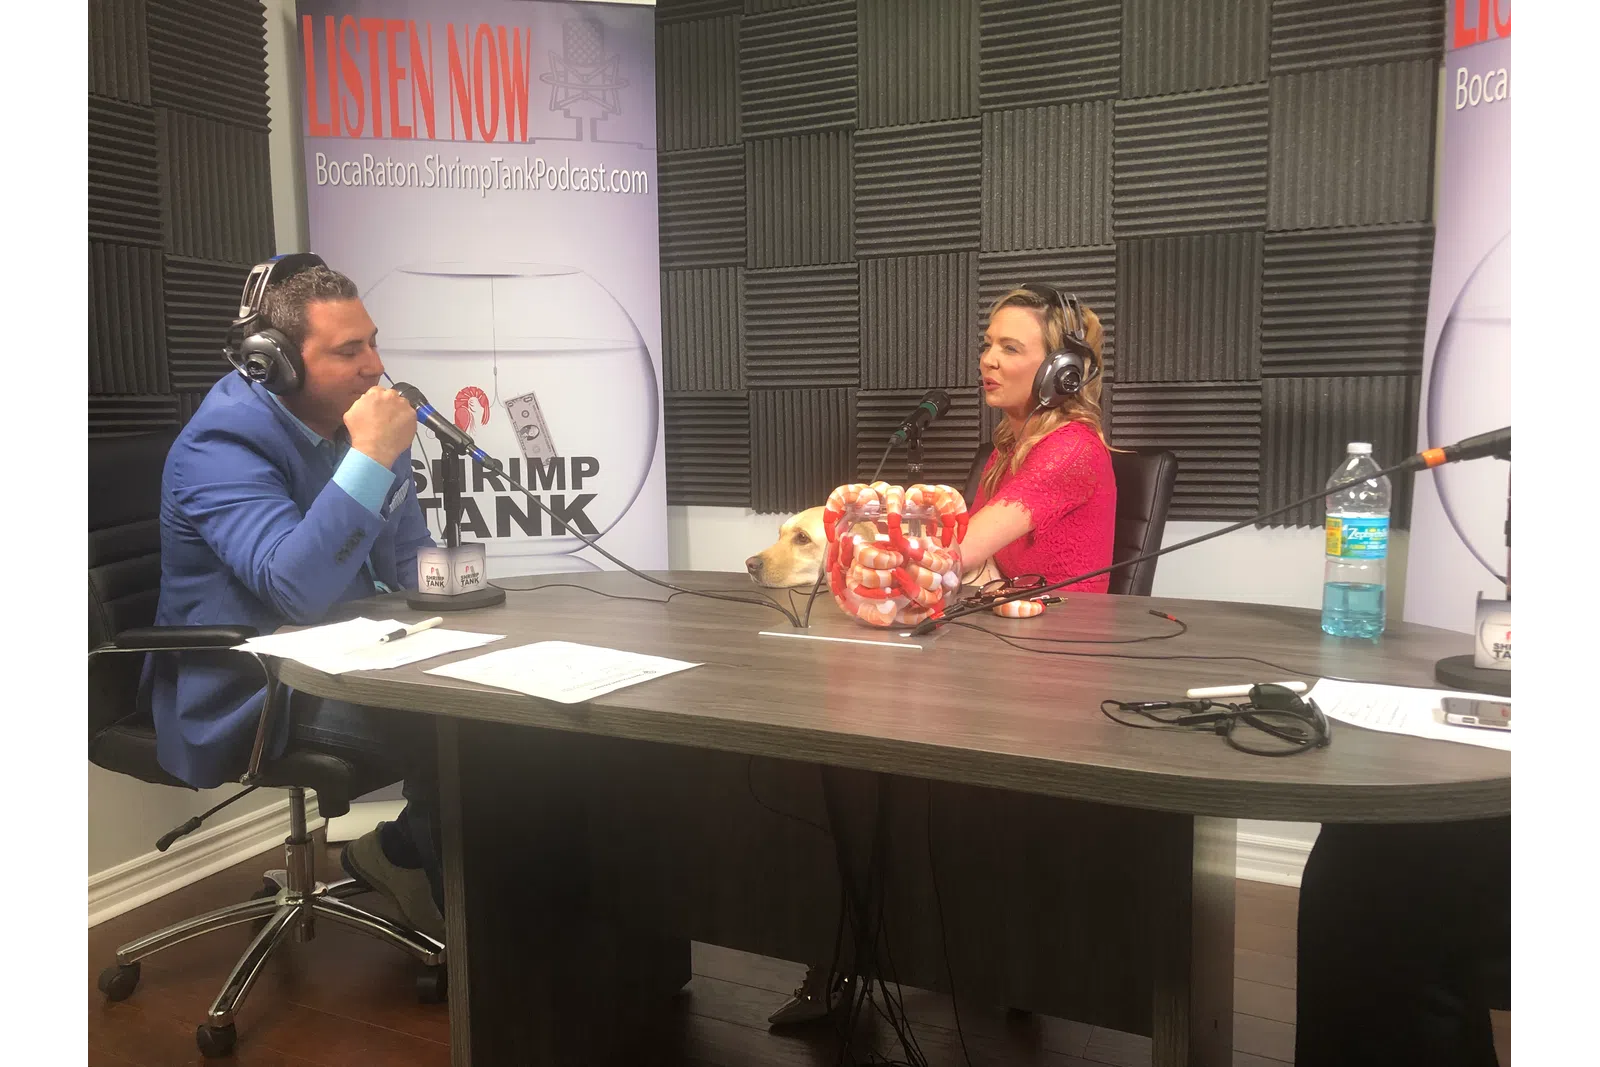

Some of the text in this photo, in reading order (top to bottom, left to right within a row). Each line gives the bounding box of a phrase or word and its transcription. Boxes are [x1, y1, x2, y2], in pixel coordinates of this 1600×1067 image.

[302, 14, 531, 143] LISTEN NOW
[1455, 66, 1512, 111] Boca
[315, 152, 649, 197] BocaRaton.ShrimpTankPodcast.com
[426, 580, 445, 588] TANK
[461, 572, 480, 581] SHRIMP
[461, 577, 480, 587] TANK
